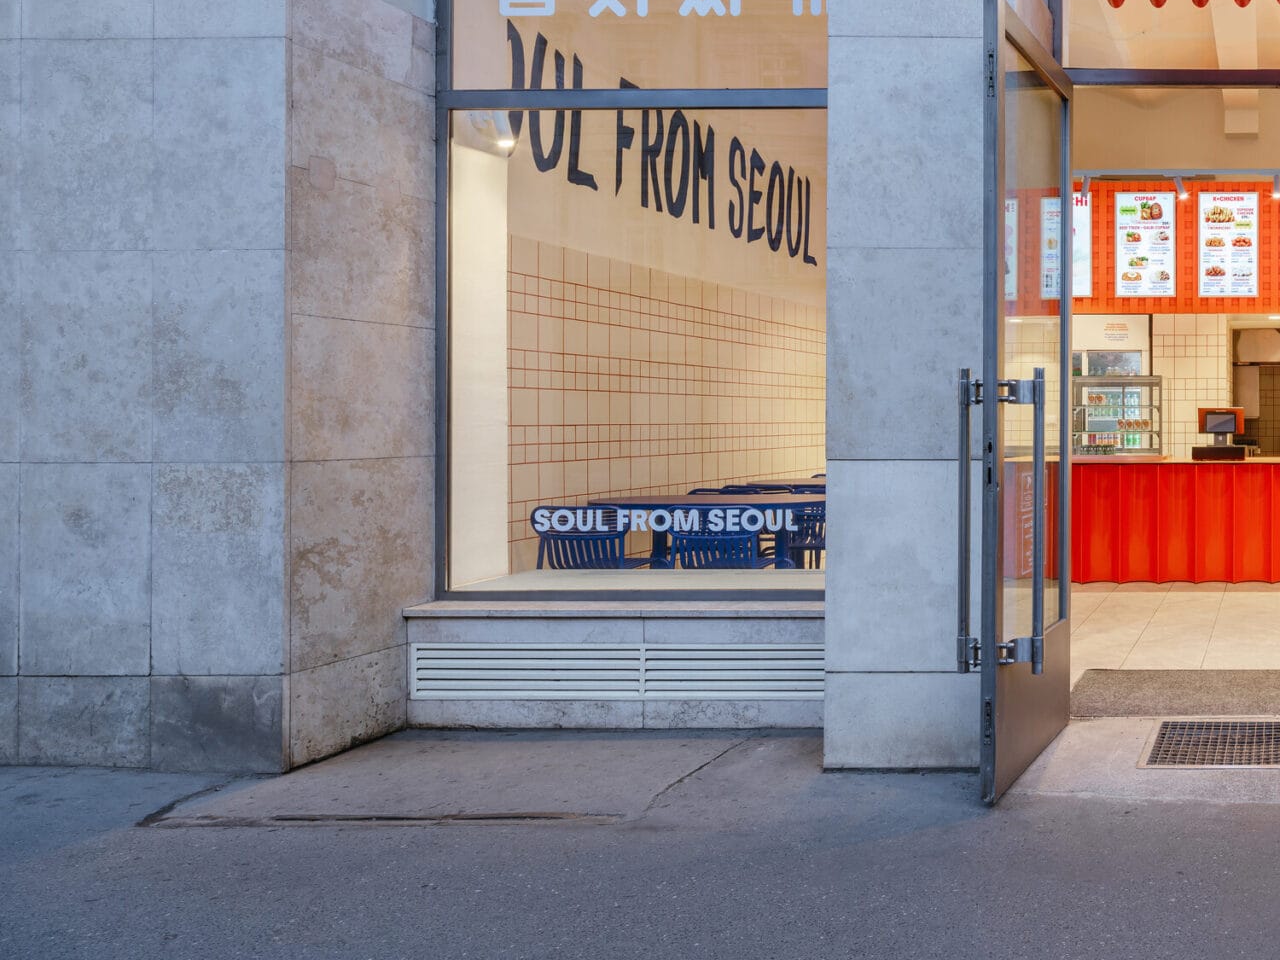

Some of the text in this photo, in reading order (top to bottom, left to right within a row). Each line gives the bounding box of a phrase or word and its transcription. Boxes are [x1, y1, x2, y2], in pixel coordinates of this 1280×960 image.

[615, 76, 715, 229] FROM
[729, 136, 817, 267] SEOUL
[534, 508, 798, 532] SOUL FROM SEOUL
